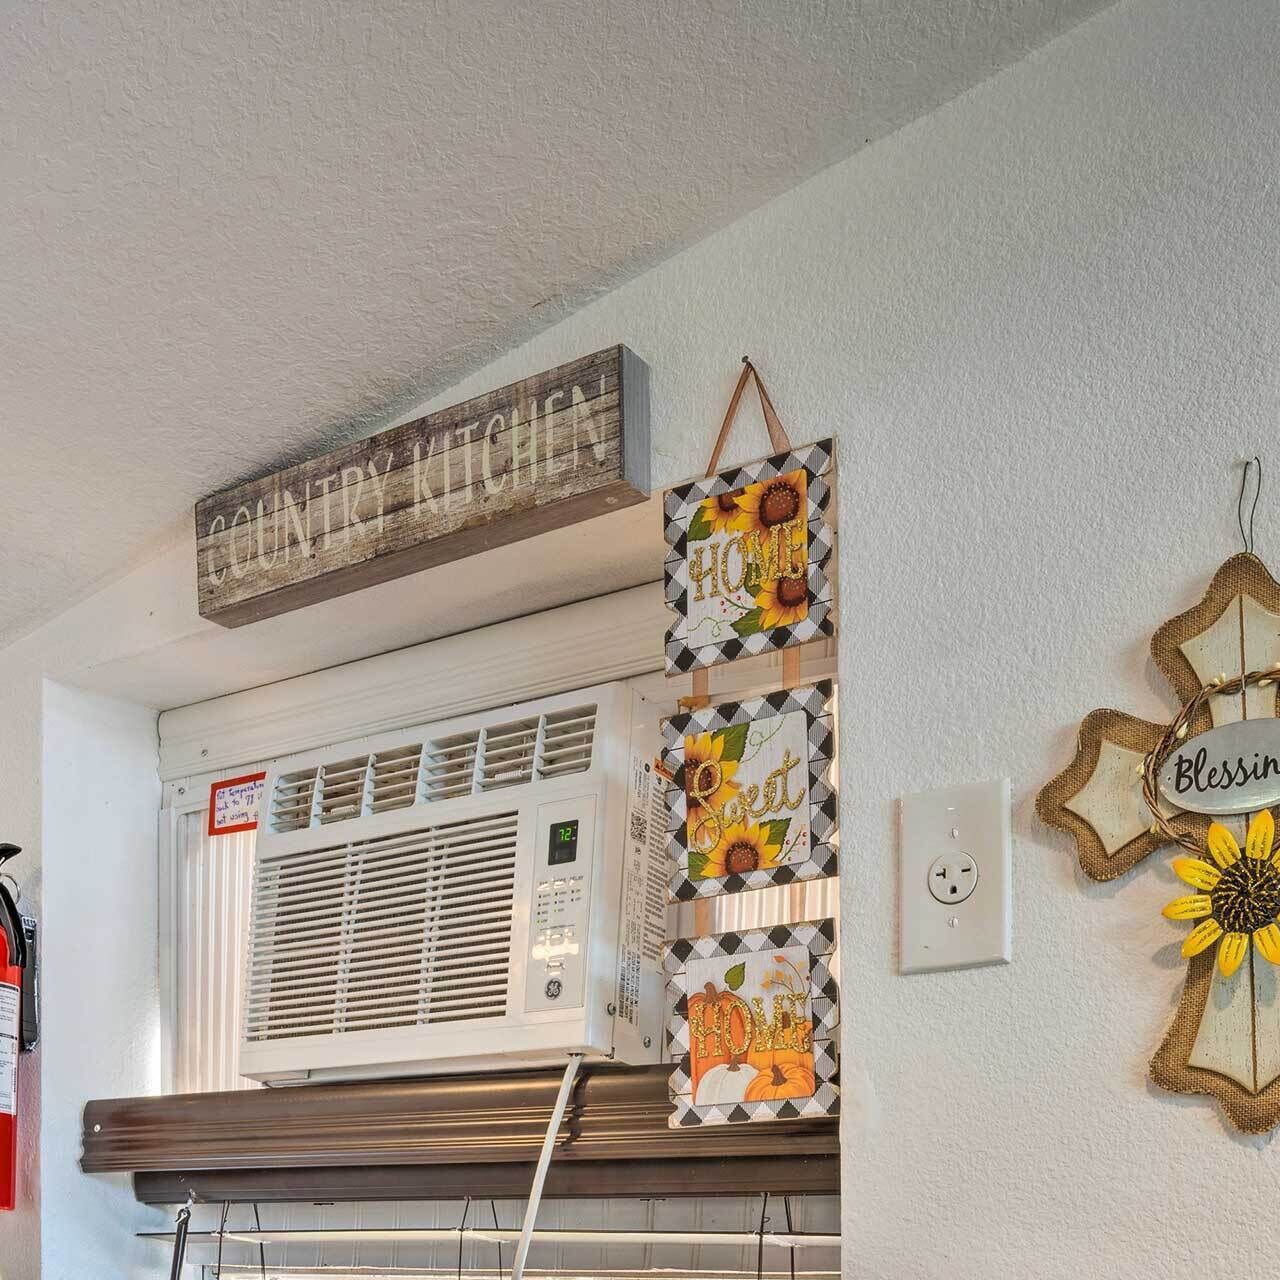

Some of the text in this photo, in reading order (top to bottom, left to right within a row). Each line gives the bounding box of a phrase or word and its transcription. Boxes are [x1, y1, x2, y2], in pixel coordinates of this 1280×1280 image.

[208, 374, 609, 586] COUNTRY KITCHEN
[689, 518, 804, 601] HOME
[689, 751, 806, 855] Sweet
[690, 991, 812, 1059] HOME
